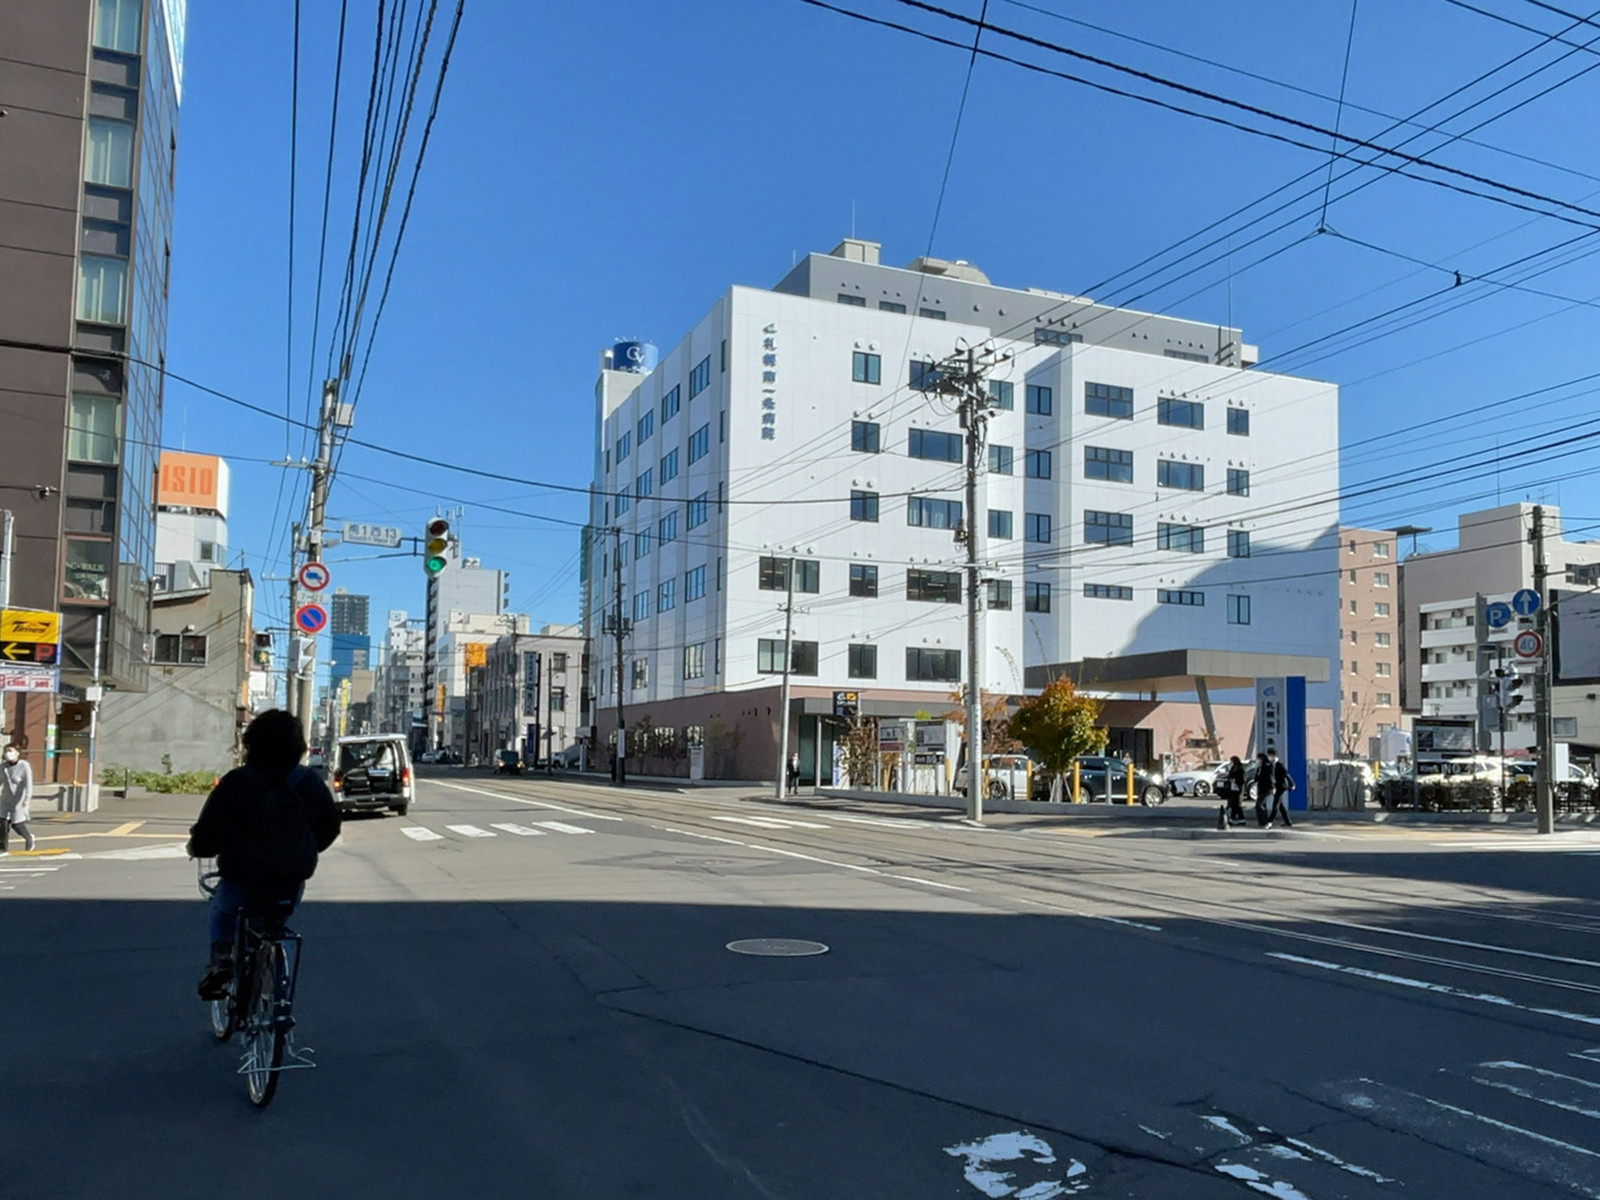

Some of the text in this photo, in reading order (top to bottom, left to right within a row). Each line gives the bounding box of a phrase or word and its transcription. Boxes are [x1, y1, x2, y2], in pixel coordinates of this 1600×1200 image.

[1490, 609, 1502, 625] P
[12, 620, 50, 634] Times
[34, 643, 54, 661] P
[1520, 638, 1536, 651] 40
